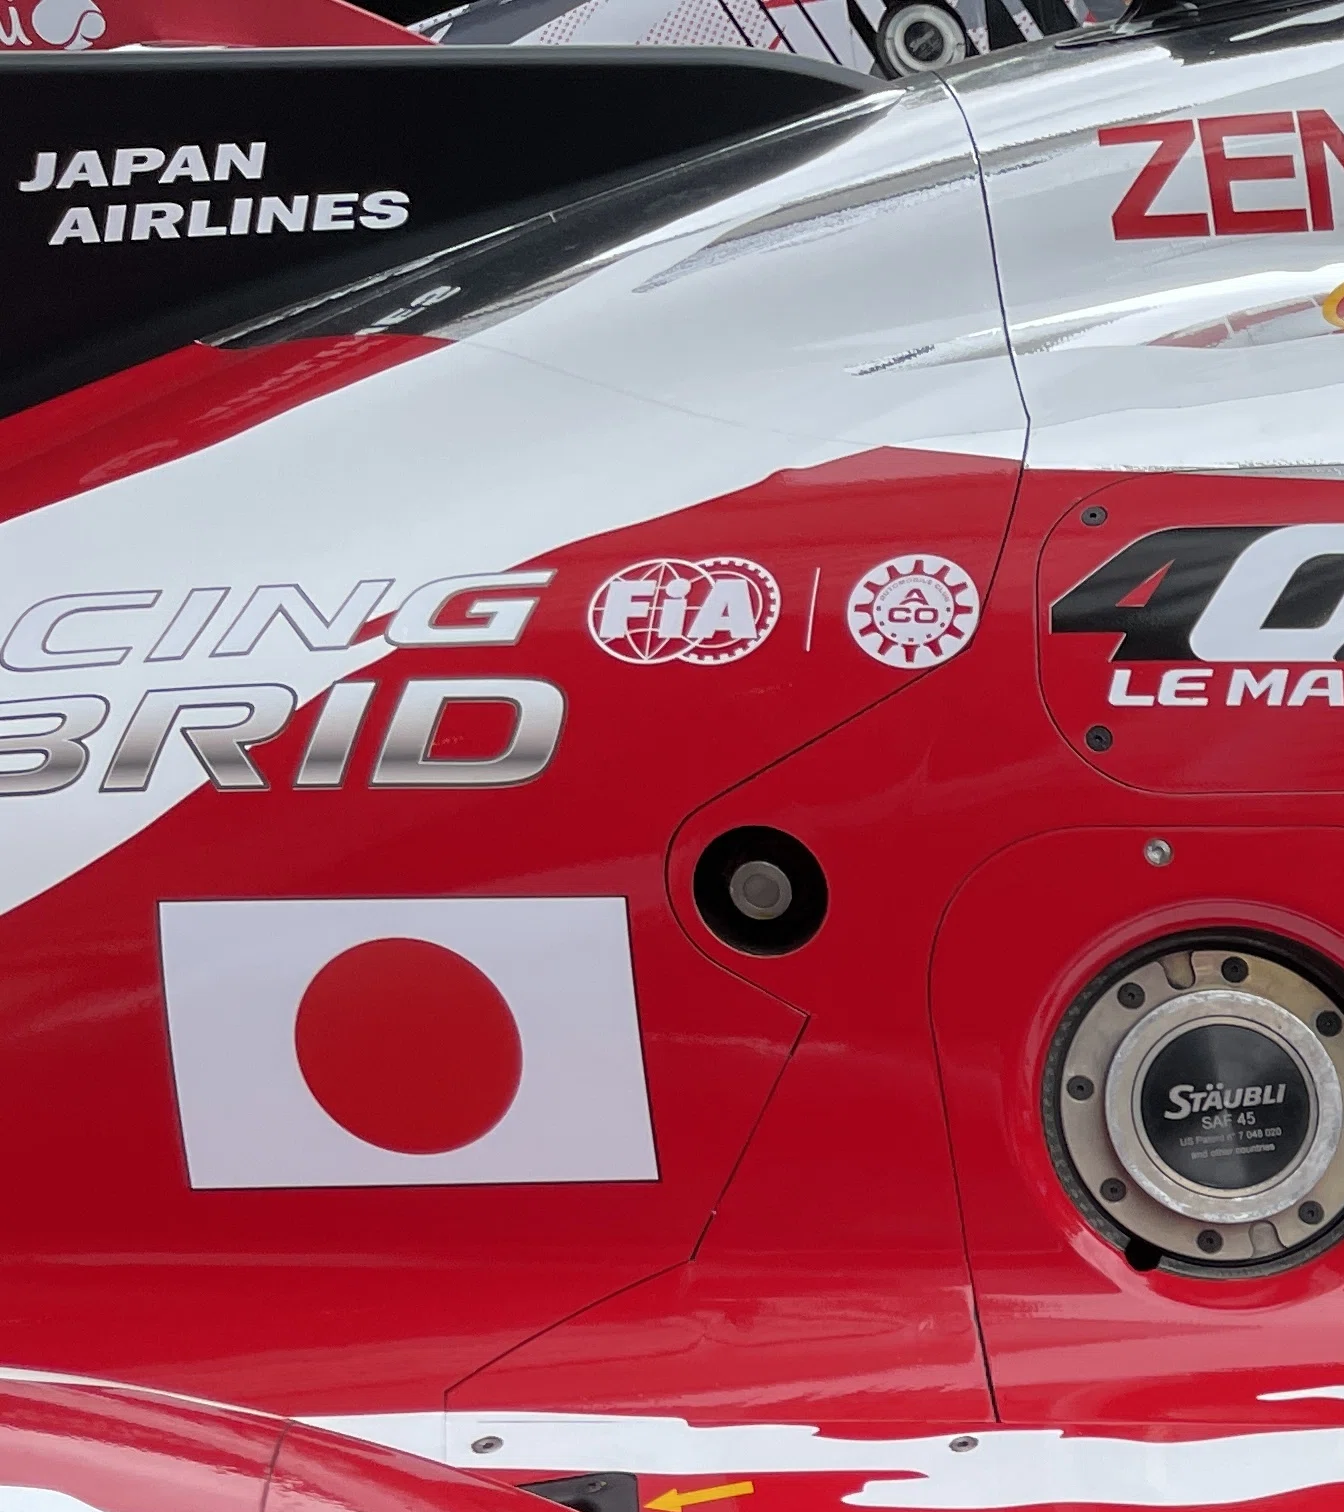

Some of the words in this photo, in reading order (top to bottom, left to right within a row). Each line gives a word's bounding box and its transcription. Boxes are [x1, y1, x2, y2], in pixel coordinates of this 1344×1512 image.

[19, 142, 266, 192] JAPAN
[48, 190, 410, 245] AIRLINES
[1108, 668, 1214, 707] LE
[1164, 1083, 1286, 1120] STÄUBLI
[1202, 1115, 1233, 1130] SAF
[1237, 1112, 1256, 1126] 45
